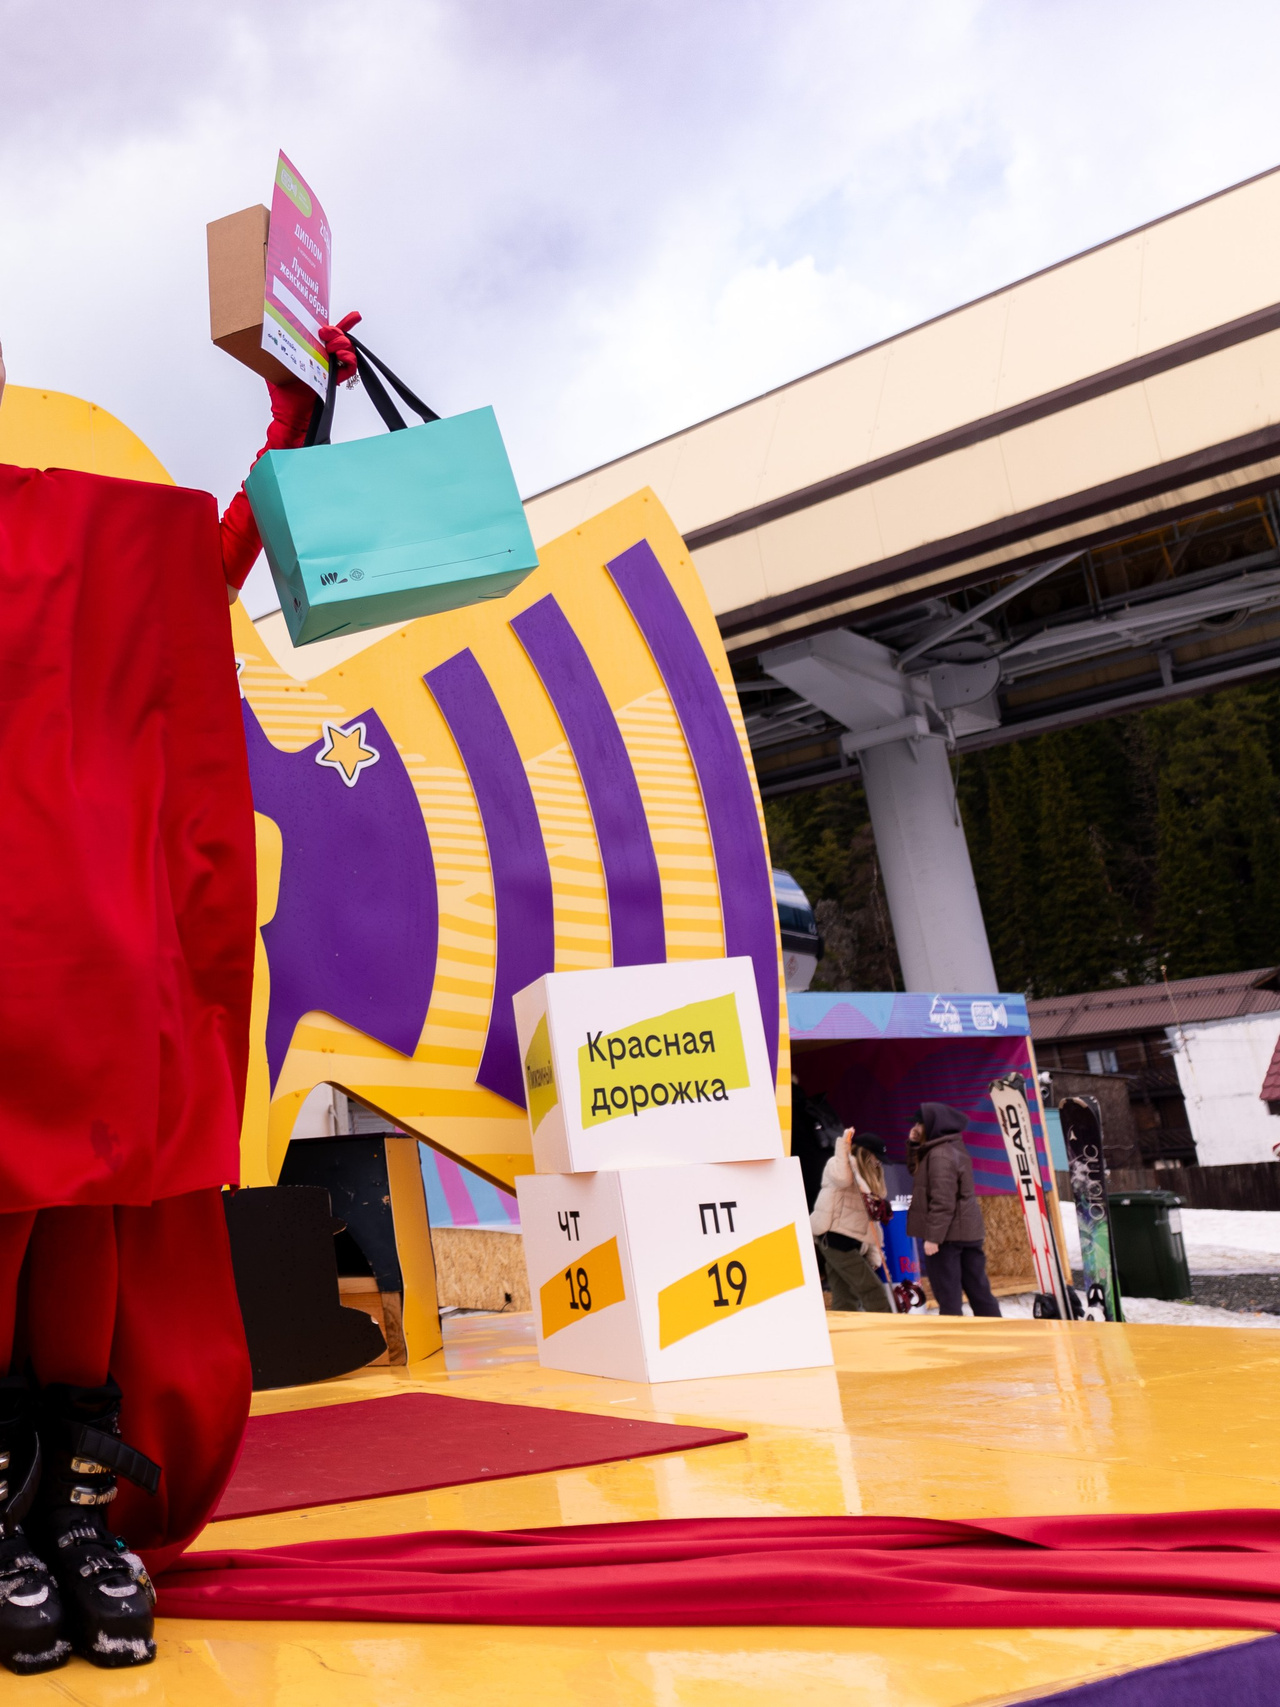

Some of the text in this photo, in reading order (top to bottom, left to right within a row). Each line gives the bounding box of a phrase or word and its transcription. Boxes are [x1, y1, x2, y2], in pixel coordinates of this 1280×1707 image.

[294, 223, 323, 265] ДИПЛОМ
[280, 261, 328, 319] женский образ
[291, 256, 319, 295] Лучший
[586, 1030, 716, 1069] Красная
[591, 1078, 729, 1116] дорожка
[1005, 1104, 1036, 1201] HEAD
[707, 1260, 748, 1308] 19
[899, 1256, 920, 1274] Re
[564, 1268, 592, 1312] 18
